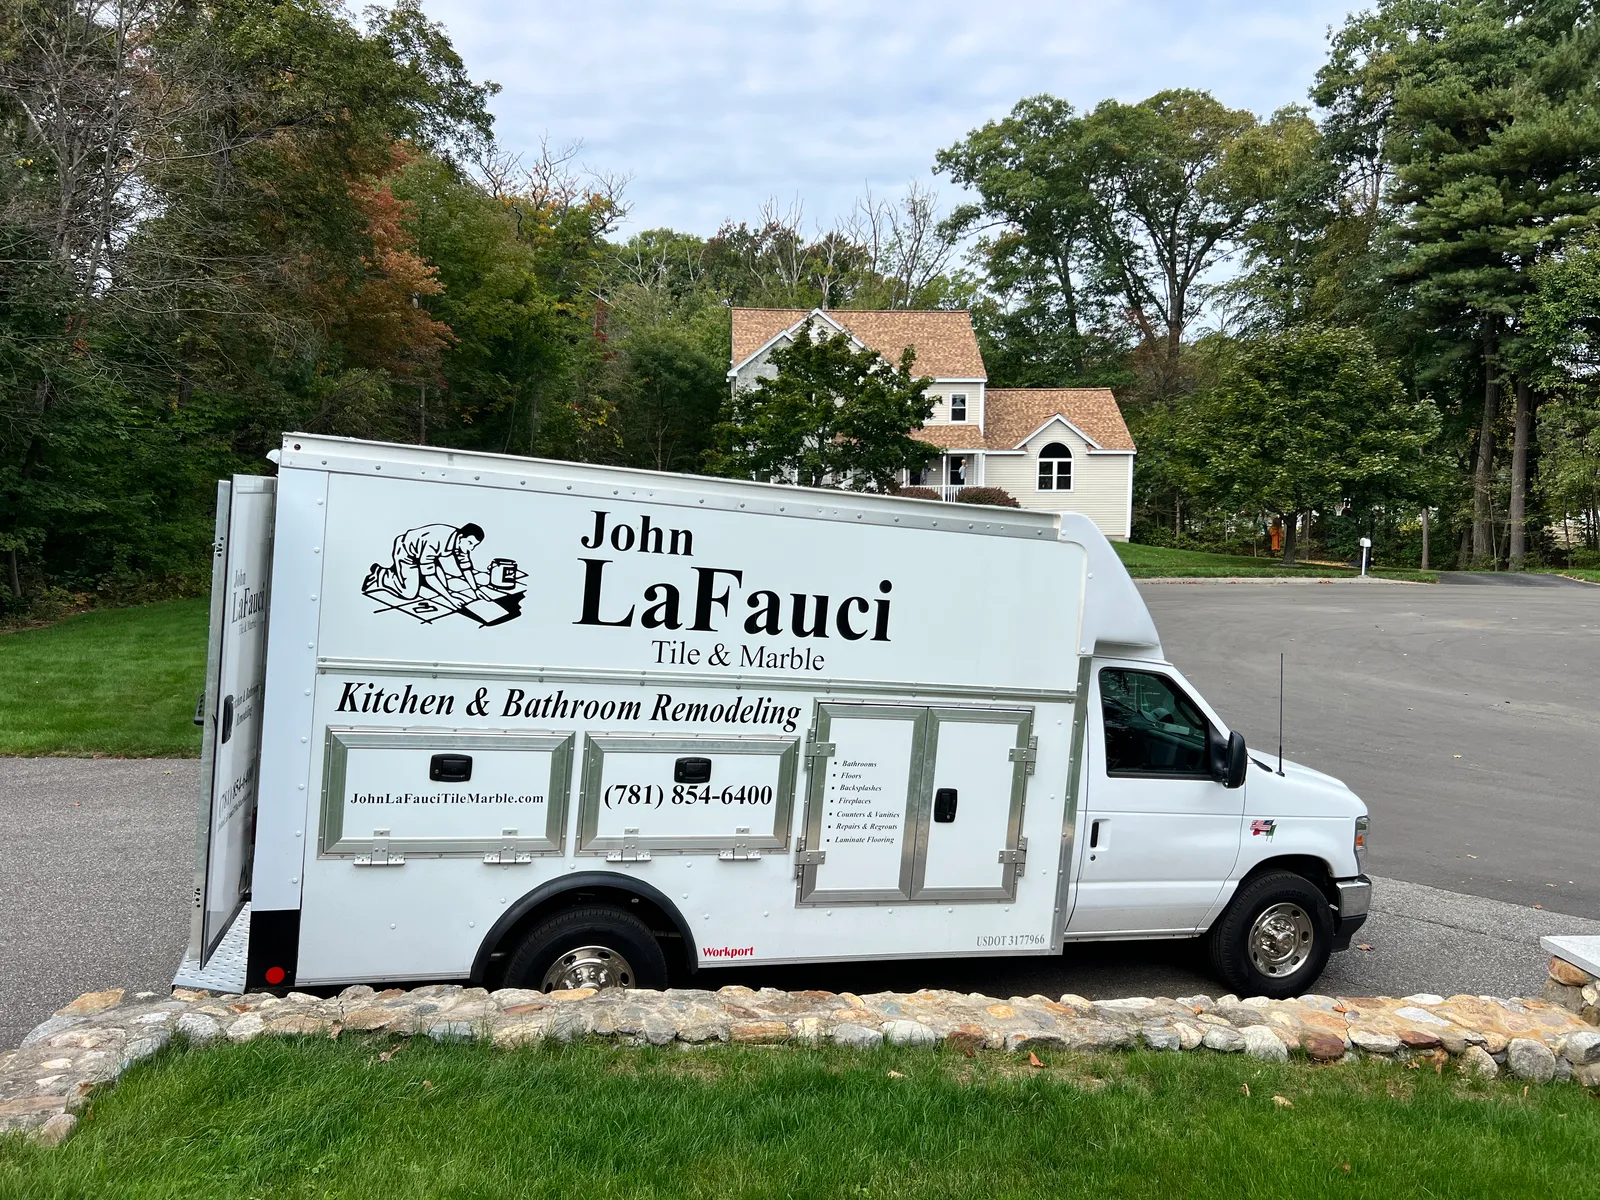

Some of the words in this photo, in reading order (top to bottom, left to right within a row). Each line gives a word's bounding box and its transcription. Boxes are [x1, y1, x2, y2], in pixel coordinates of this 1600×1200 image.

[580, 510, 694, 556] John
[232, 582, 265, 624] LaFauci
[572, 559, 893, 642] LaFauci
[652, 641, 701, 666] Tile
[708, 643, 731, 667] &
[741, 644, 825, 671] Marble
[335, 681, 455, 716] Kitchen
[465, 687, 491, 717] &
[501, 687, 645, 721] Bathroom
[650, 692, 802, 733] Remodeling
[842, 760, 877, 768] Bathrooms
[840, 784, 882, 792] Backsplashes
[351, 792, 544, 805] JohnLaFauciTileMarble.com
[604, 784, 664, 810] (781)
[671, 784, 773, 806] 854-6400
[839, 797, 871, 805] Fireplaces
[836, 823, 860, 831] Repairs
[870, 823, 898, 831] Regrouts
[976, 935, 1007, 947] USDOT
[1009, 934, 1045, 946] 3177966
[703, 946, 754, 959] Workport
